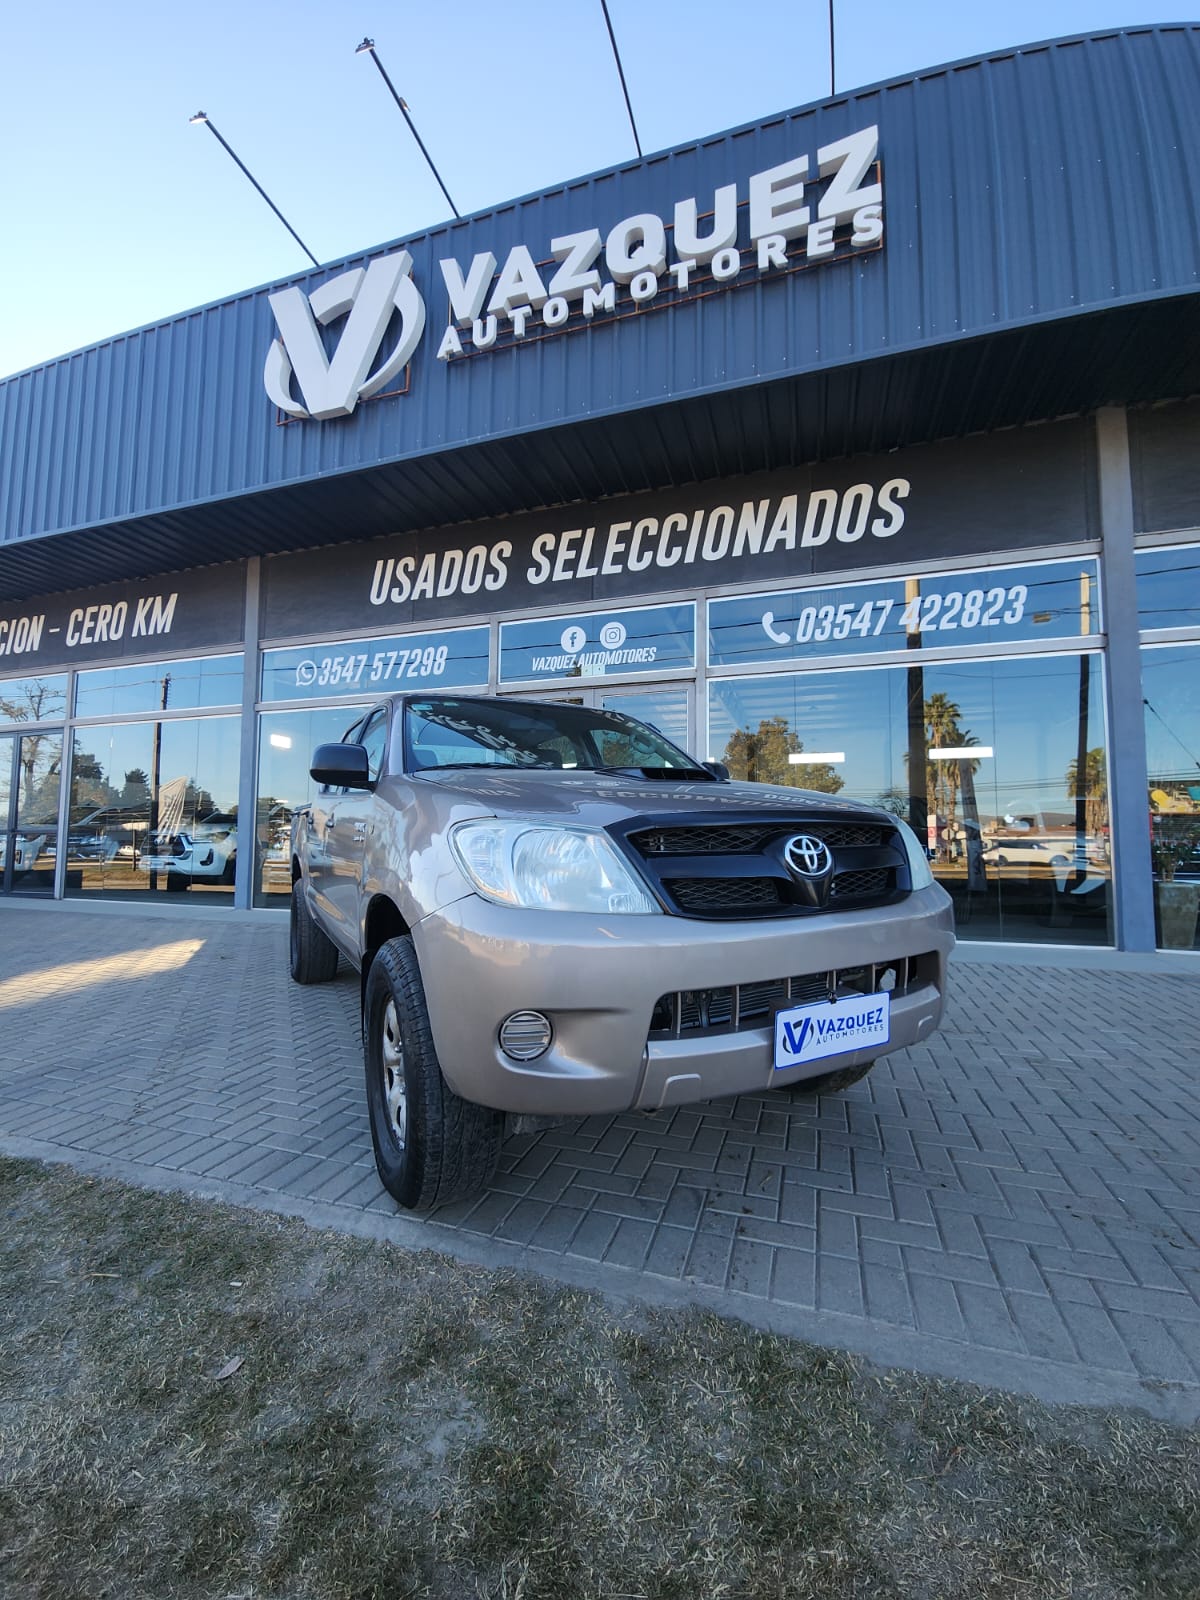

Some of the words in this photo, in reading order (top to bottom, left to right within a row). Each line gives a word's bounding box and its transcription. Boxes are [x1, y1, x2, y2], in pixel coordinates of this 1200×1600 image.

[438, 125, 883, 328] VAZQUEZ
[436, 204, 884, 361] AUTOMOTORES
[369, 541, 513, 606] USADOS
[526, 478, 911, 586] SELECCIONADOS
[65, 600, 128, 647] CERO
[131, 592, 179, 638] KM
[796, 599, 894, 643] 03547
[899, 584, 1028, 634] 422823
[317, 654, 369, 686] 3547
[370, 645, 449, 681] 577298
[532, 654, 576, 671] VAZQUEZ
[577, 646, 657, 668] AUTOMOTORES
[816, 1007, 883, 1035] VAZQUEZ
[816, 1024, 884, 1045] AUTOMOTORES
